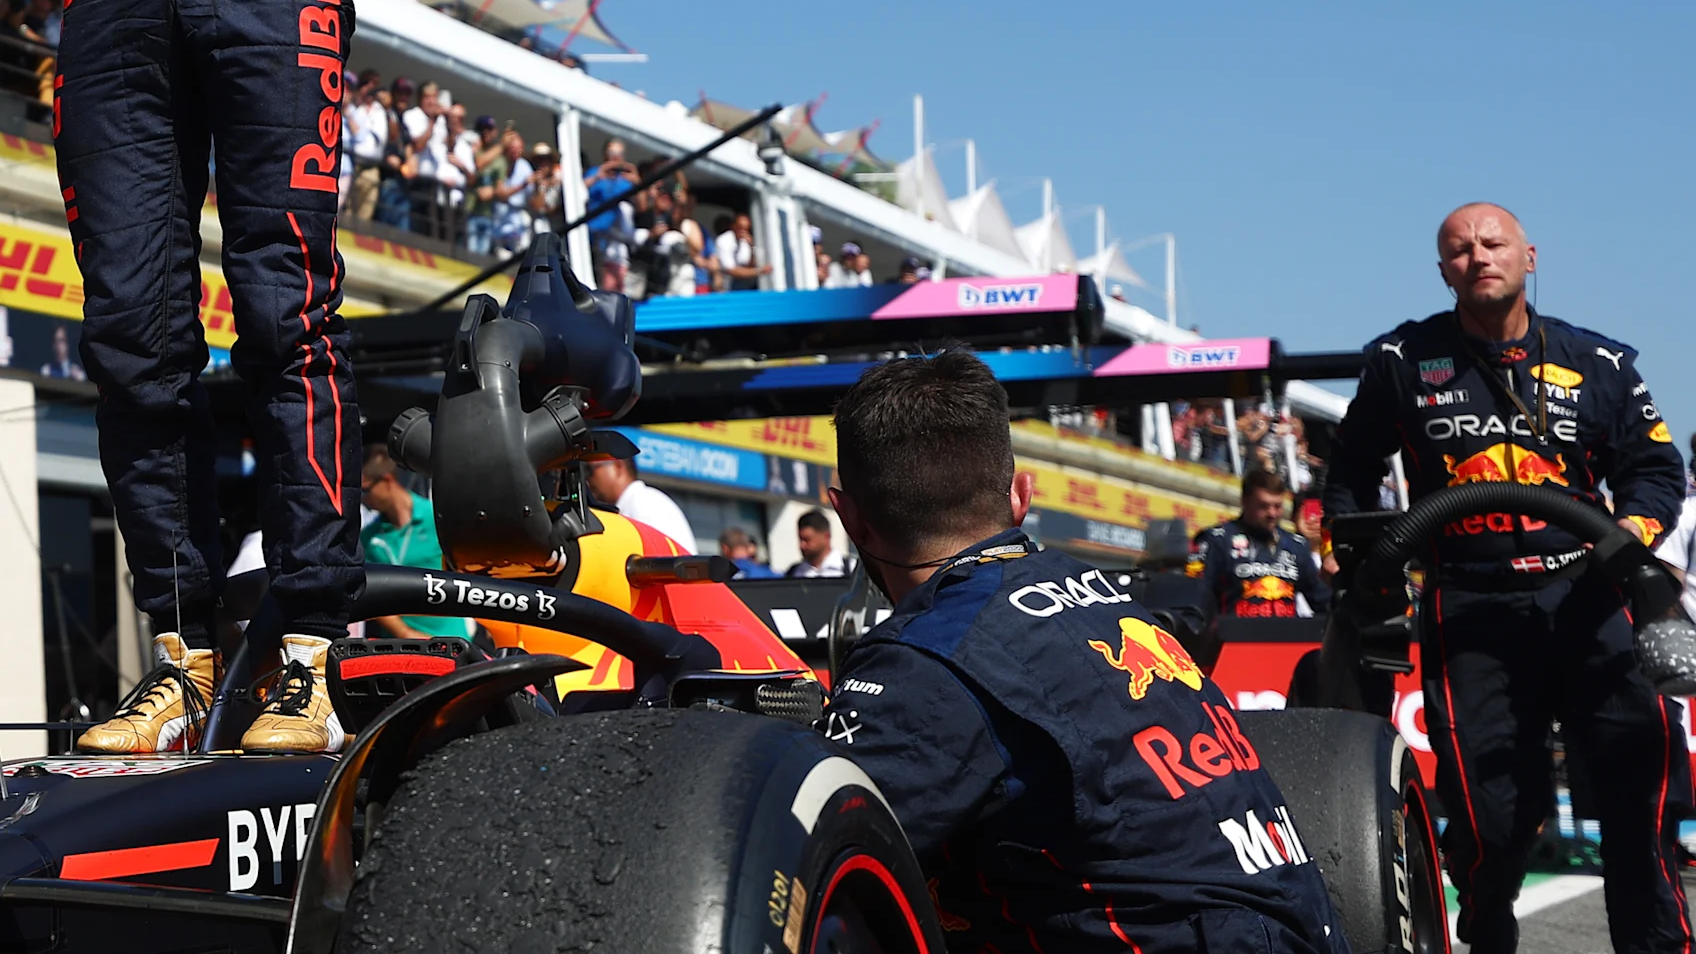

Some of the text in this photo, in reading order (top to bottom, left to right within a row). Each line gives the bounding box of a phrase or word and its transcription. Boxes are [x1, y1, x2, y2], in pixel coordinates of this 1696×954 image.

[289, 52, 344, 194] Red
[984, 287, 1041, 305] BWT
[1190, 348, 1238, 364] BWT
[1423, 360, 1452, 370] TAG
[1416, 390, 1454, 408] Mobil
[1425, 414, 1578, 443] ORACE
[454, 579, 530, 613] Tezos
[1008, 568, 1133, 618] ORACL
